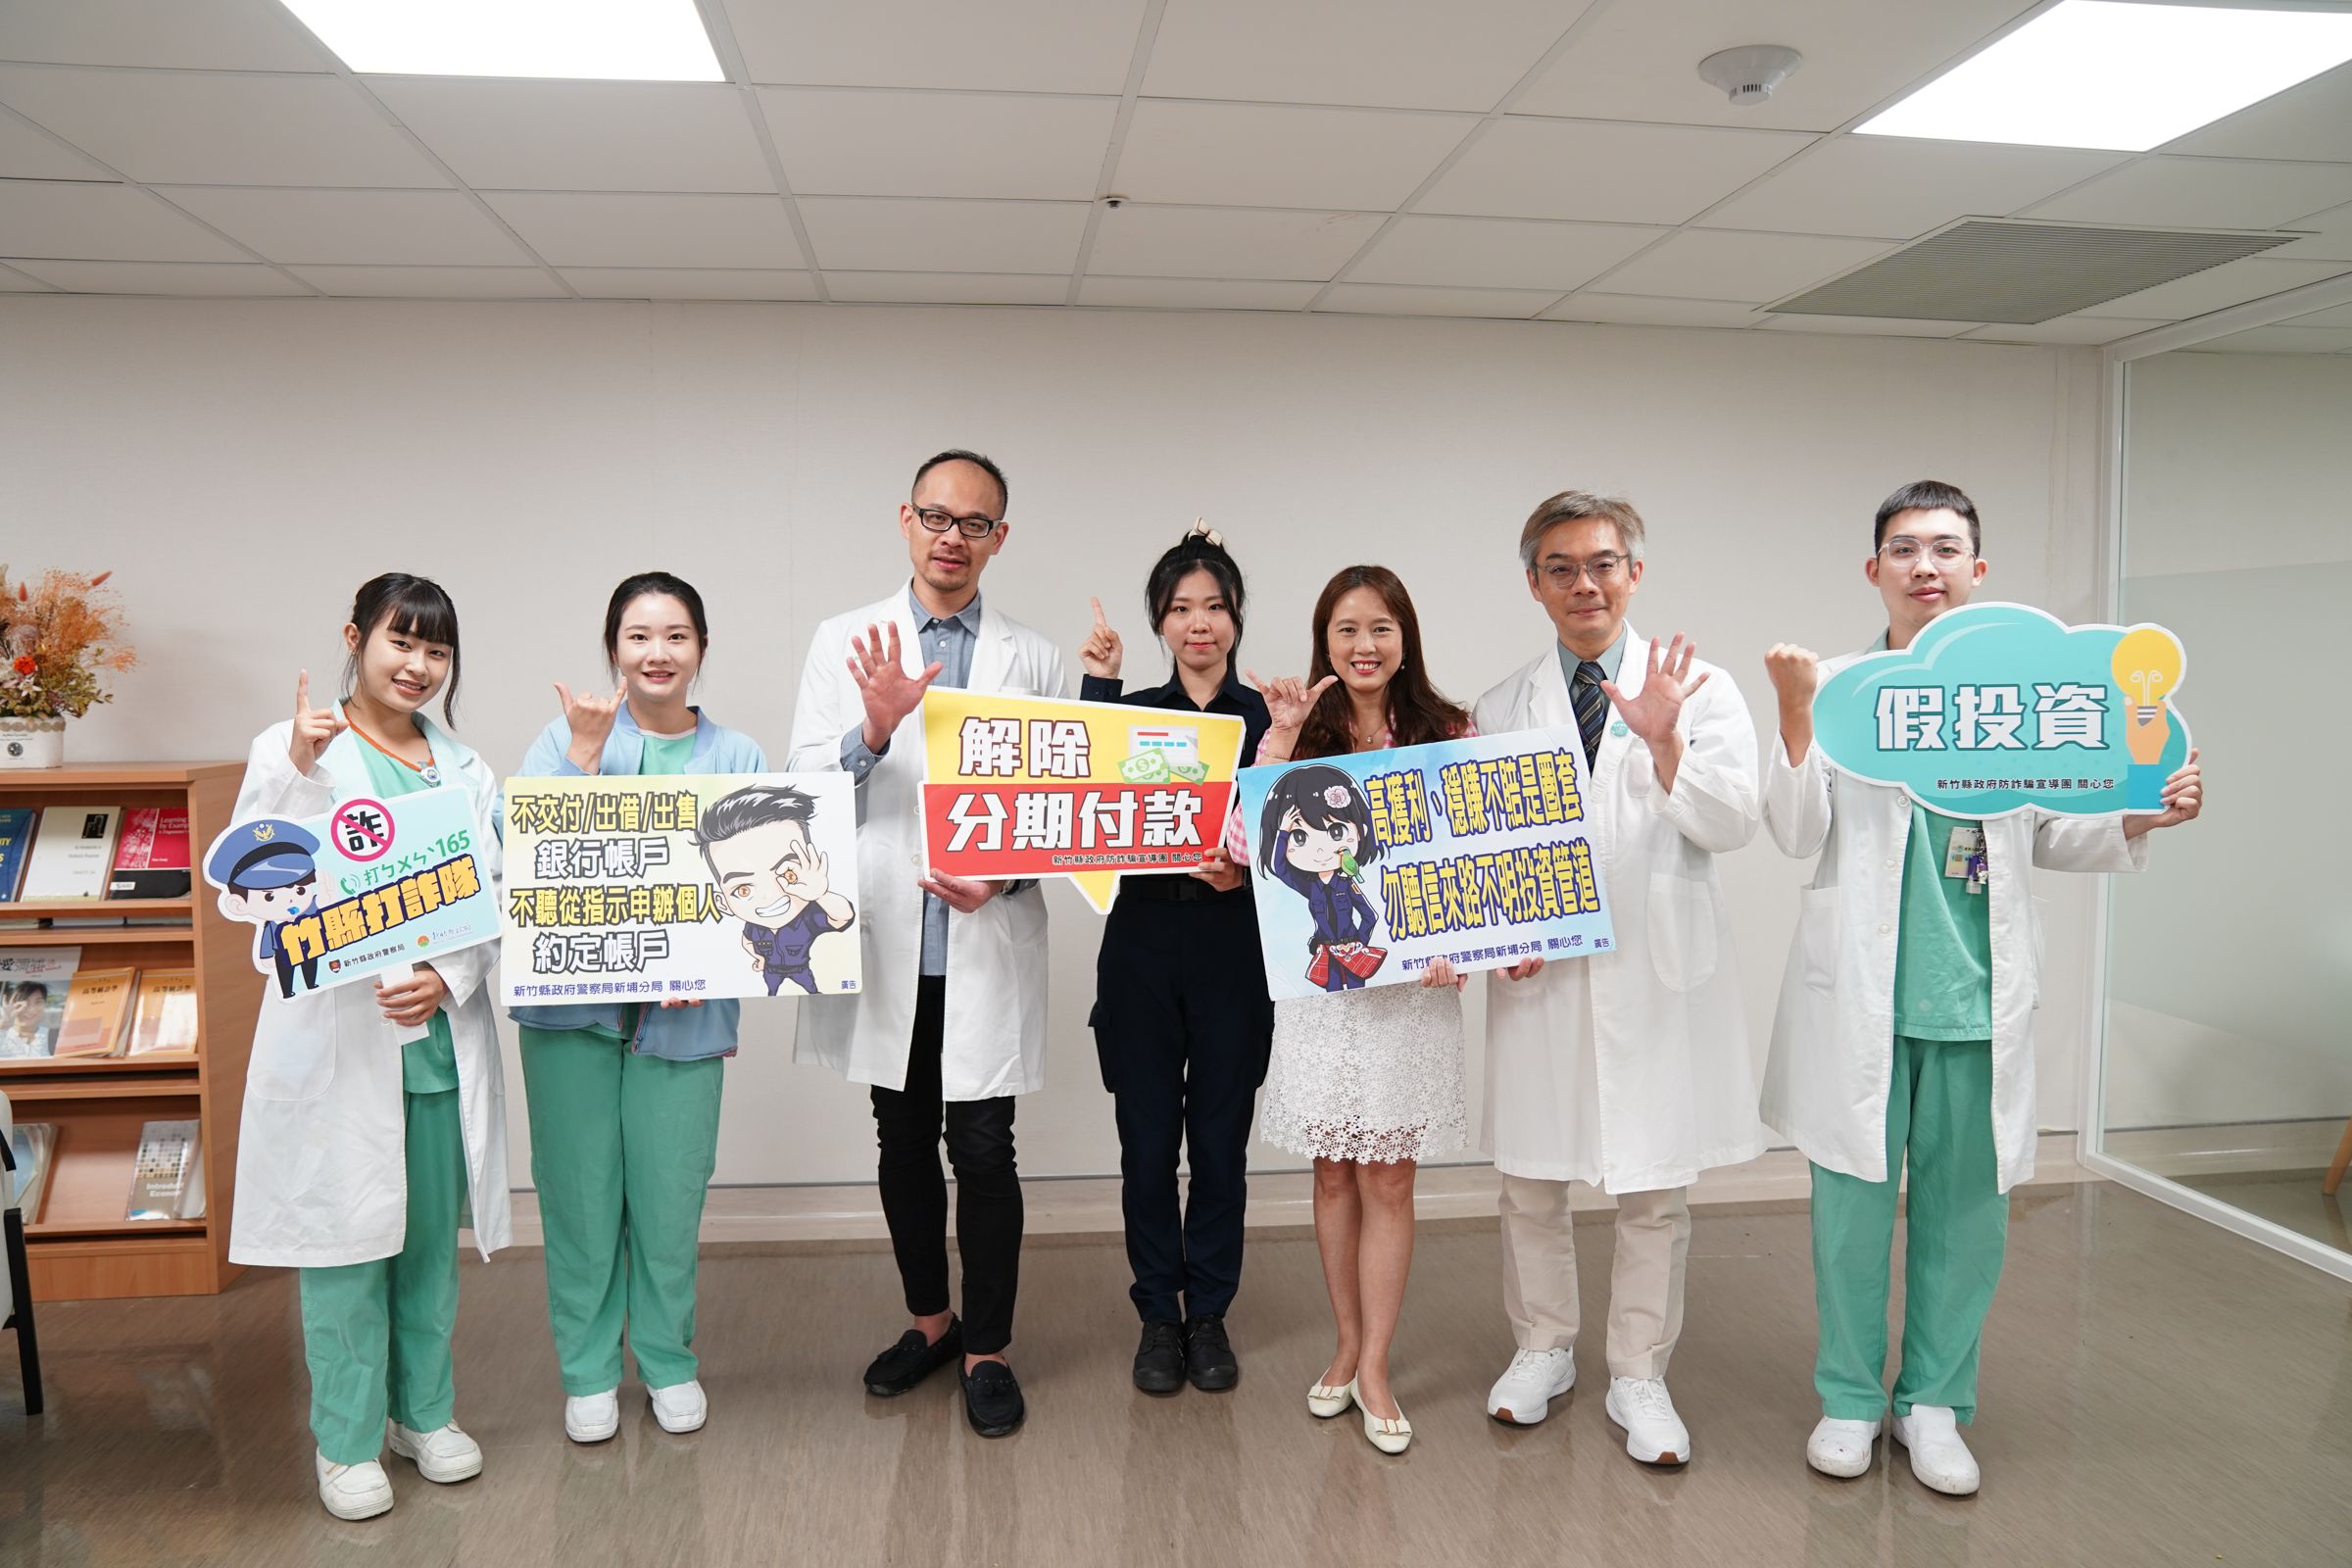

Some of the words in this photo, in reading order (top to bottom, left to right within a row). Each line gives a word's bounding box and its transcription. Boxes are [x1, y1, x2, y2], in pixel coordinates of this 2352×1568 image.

[1874, 682, 2109, 752] 假投資
[958, 716, 1091, 778] 解除
[1365, 748, 1584, 848] 高獲利、穩賺不賠是圈套
[1936, 778, 2072, 790] 新竹縣政府防詐騙宣導團
[2078, 778, 2114, 790] 關心您
[513, 792, 698, 833] 不交付/出借/出售
[946, 789, 1202, 852] 分期付款
[535, 839, 669, 879] 銀行帳戶
[1053, 854, 1168, 865] 新竹縣政府防詐騙宣導團
[1171, 852, 1202, 862] 關心您
[277, 855, 480, 967] 竹縣打詐隊
[511, 883, 723, 927] 不聽從指示申辦個人
[1381, 838, 1600, 942] 勿聽信來路不明投資管道
[344, 944, 406, 967] 新竹縣政府警察局
[533, 929, 669, 974] 約定帳戶
[1547, 934, 1584, 951] 關心您
[514, 980, 663, 997] 新竹縣政府警察局新埔分局
[669, 979, 707, 992] 關心您
